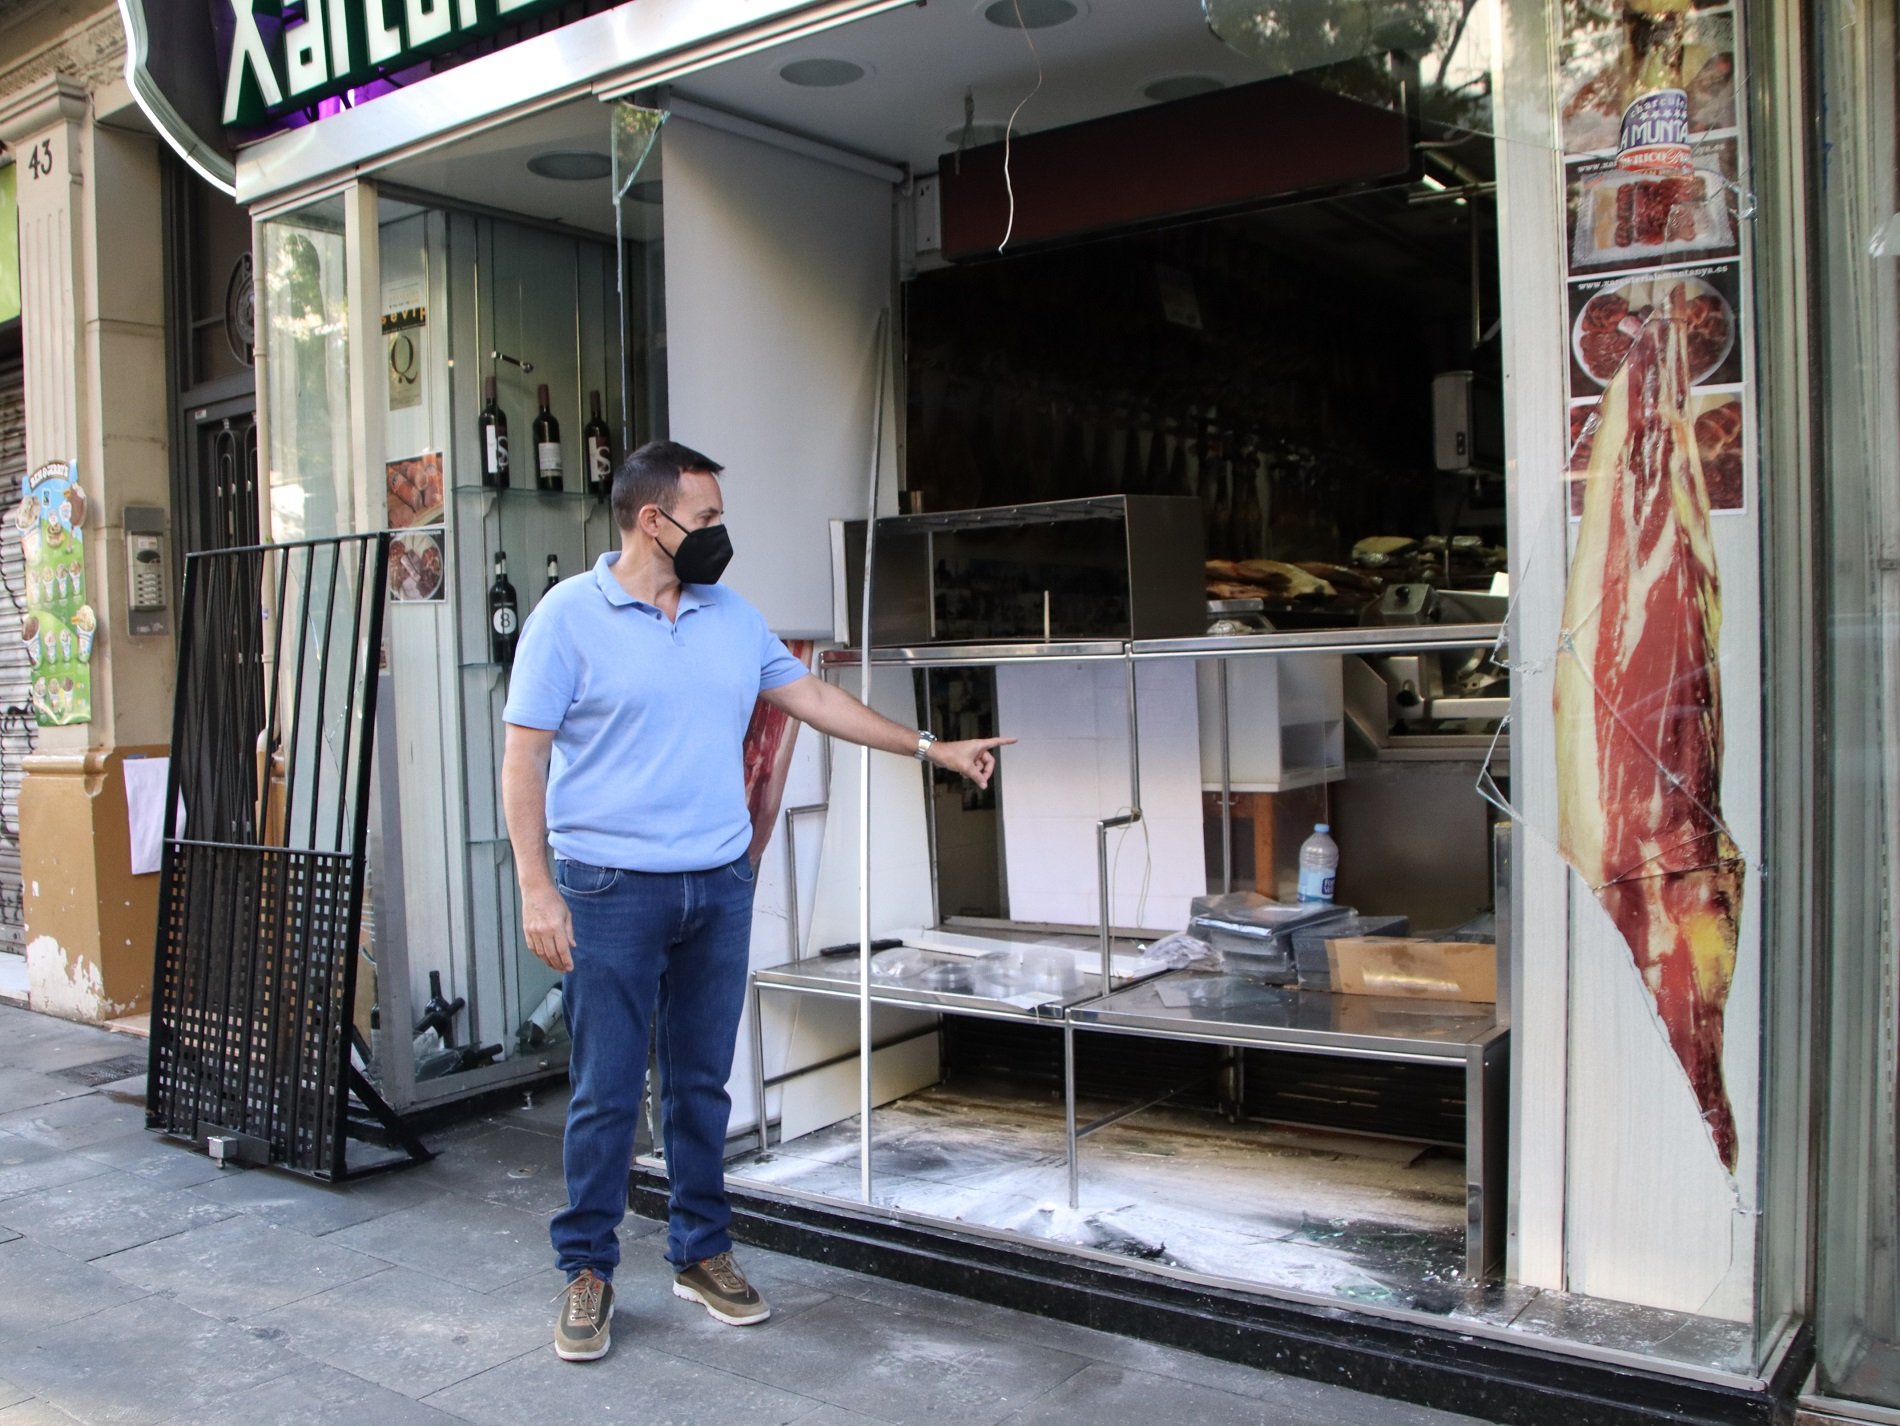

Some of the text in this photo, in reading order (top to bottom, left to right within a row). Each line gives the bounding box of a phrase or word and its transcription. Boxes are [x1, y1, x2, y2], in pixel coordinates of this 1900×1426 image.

[28, 138, 52, 180] 43
[390, 335, 418, 385] Q
[501, 613, 511, 628] 8
